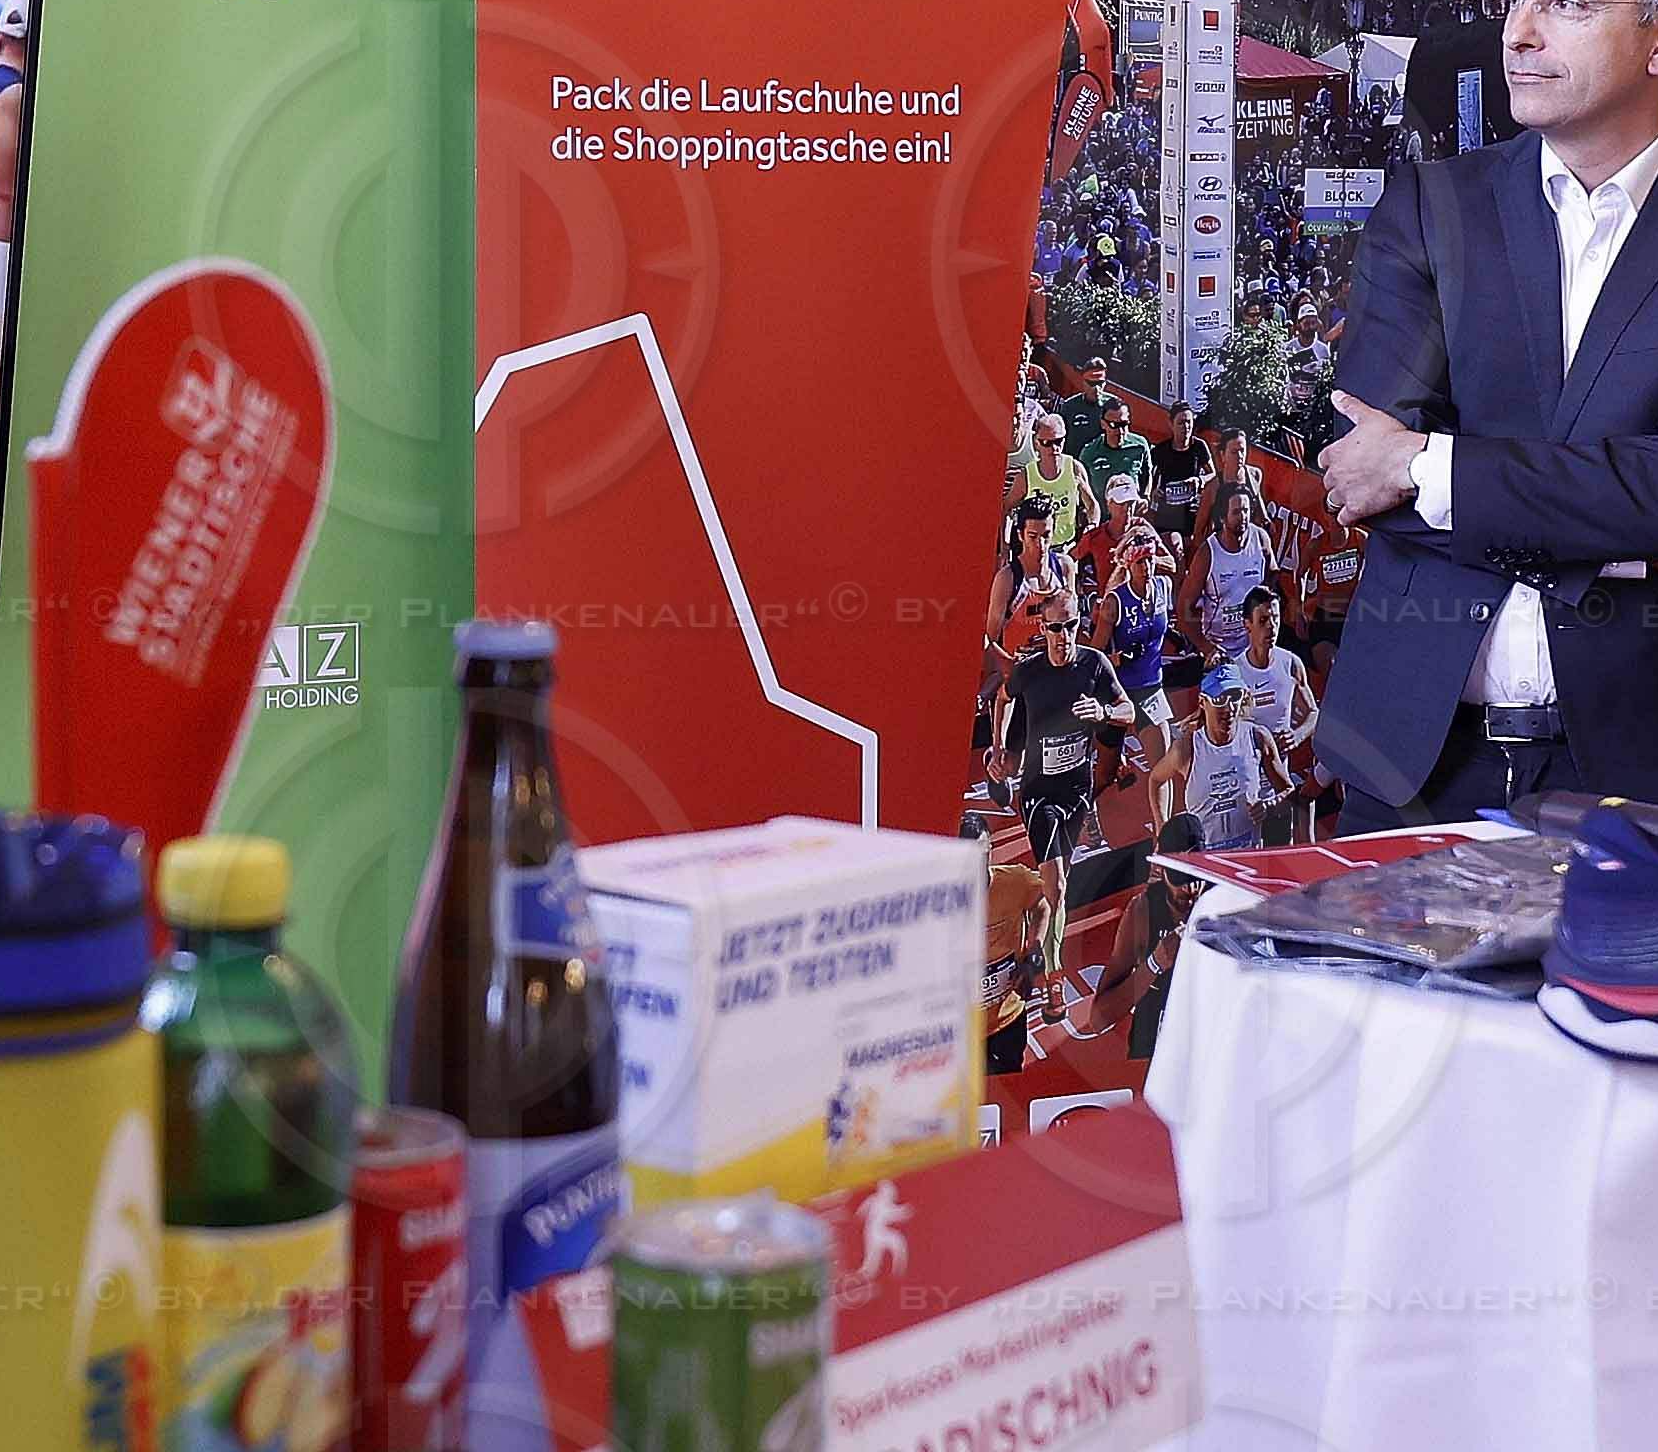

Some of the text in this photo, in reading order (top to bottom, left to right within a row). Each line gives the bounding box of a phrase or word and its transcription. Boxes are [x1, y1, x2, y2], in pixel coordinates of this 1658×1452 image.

[1134, 11, 1163, 22] PUNTIG
[551, 78, 961, 116] Pack die Laufschuhe und
[1063, 85, 1092, 137] KLEINE
[1236, 98, 1293, 119] KLEINE
[1071, 92, 1101, 141] ZEITUNG
[551, 128, 952, 171] die Shoppingtasche ein!
[1324, 190, 1364, 202] BLOCK
[265, 685, 359, 710] HOLDING
[716, 966, 780, 1013] UND
[981, 974, 1000, 990] 95
